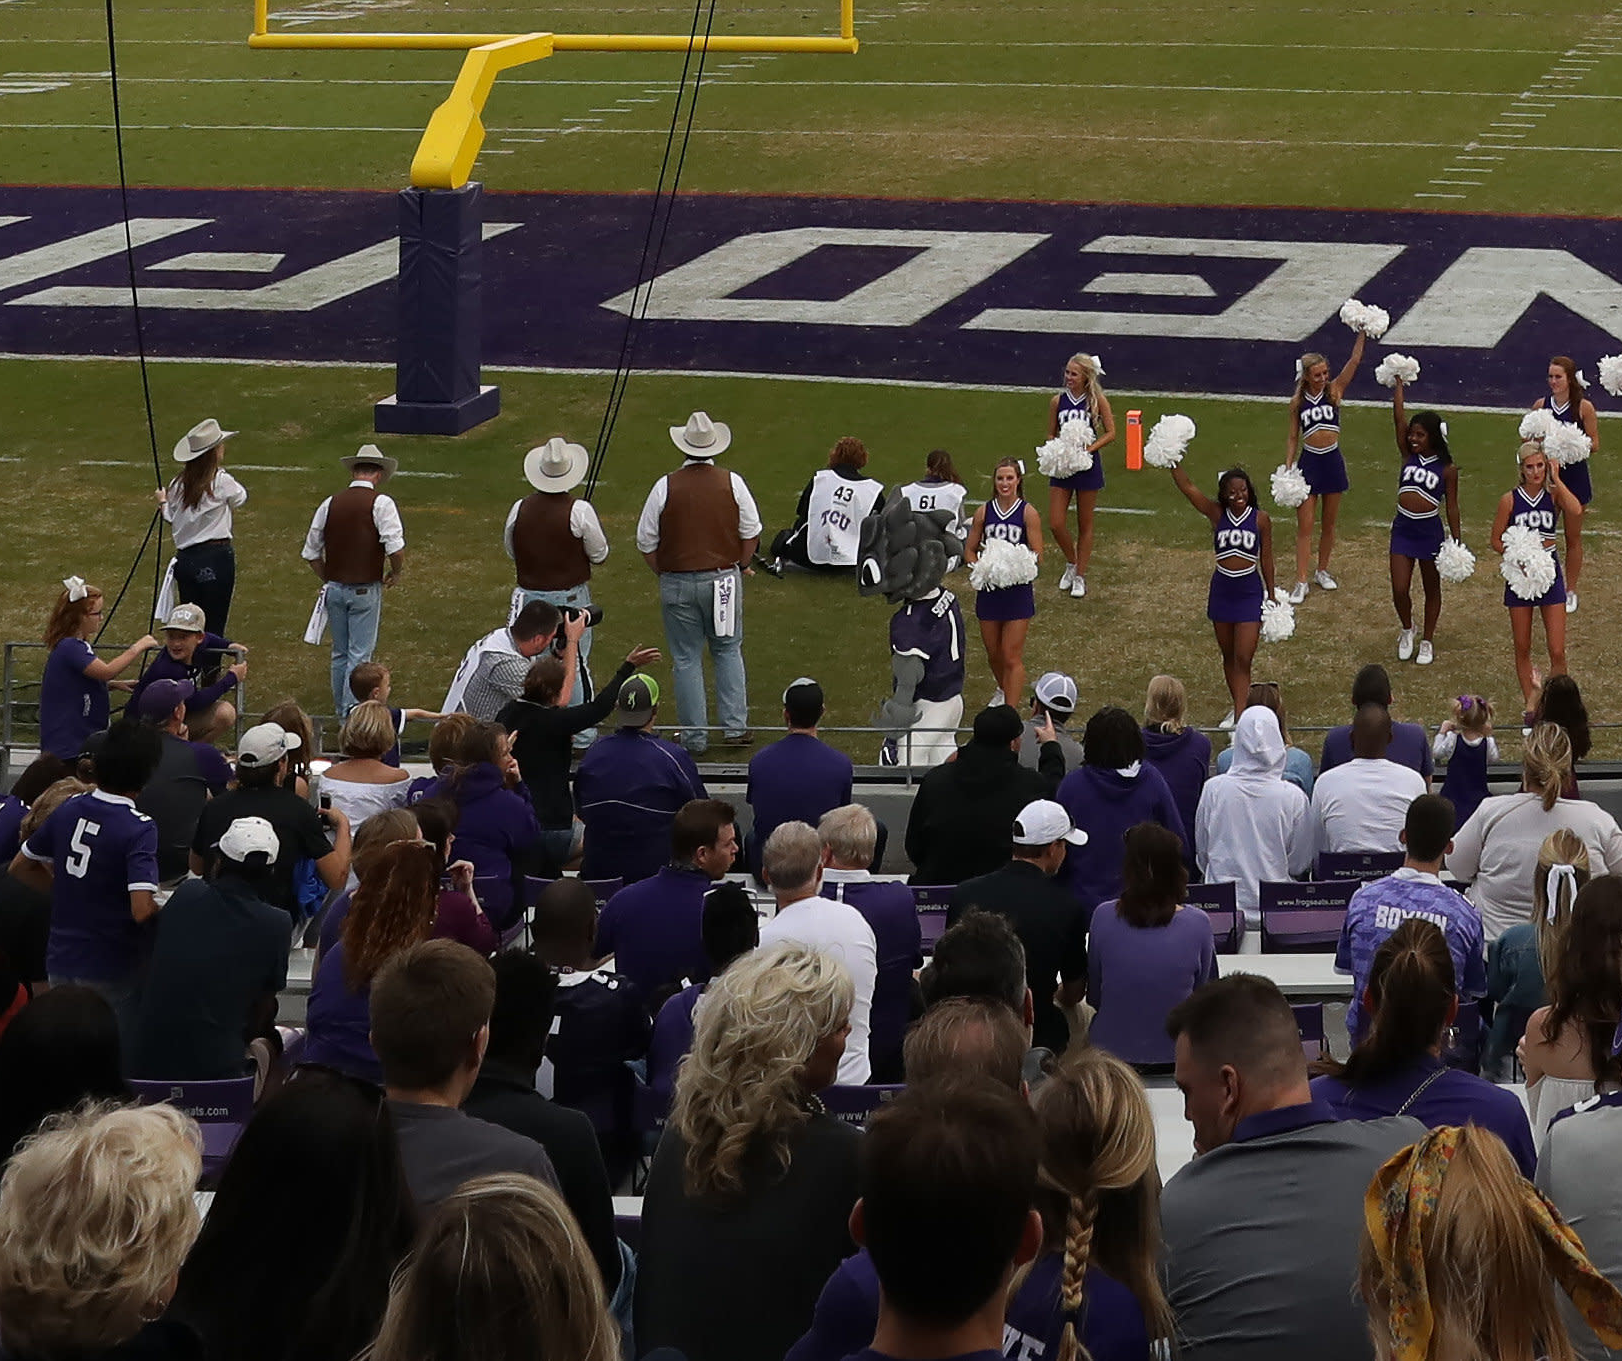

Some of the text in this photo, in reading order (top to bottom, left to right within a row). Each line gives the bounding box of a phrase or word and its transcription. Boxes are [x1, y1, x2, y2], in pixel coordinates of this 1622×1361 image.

[1300, 404, 1335, 426] TCU
[1403, 464, 1439, 490] TCU
[834, 485, 854, 502] 43
[920, 495, 936, 510] 61
[821, 510, 851, 531] TCU
[1515, 509, 1554, 528] TCU
[985, 524, 1023, 544] TCU
[1218, 529, 1256, 547] TCU
[947, 609, 960, 662] 1
[66, 816, 101, 879] 5
[1277, 897, 1346, 908] www.frogseats.com
